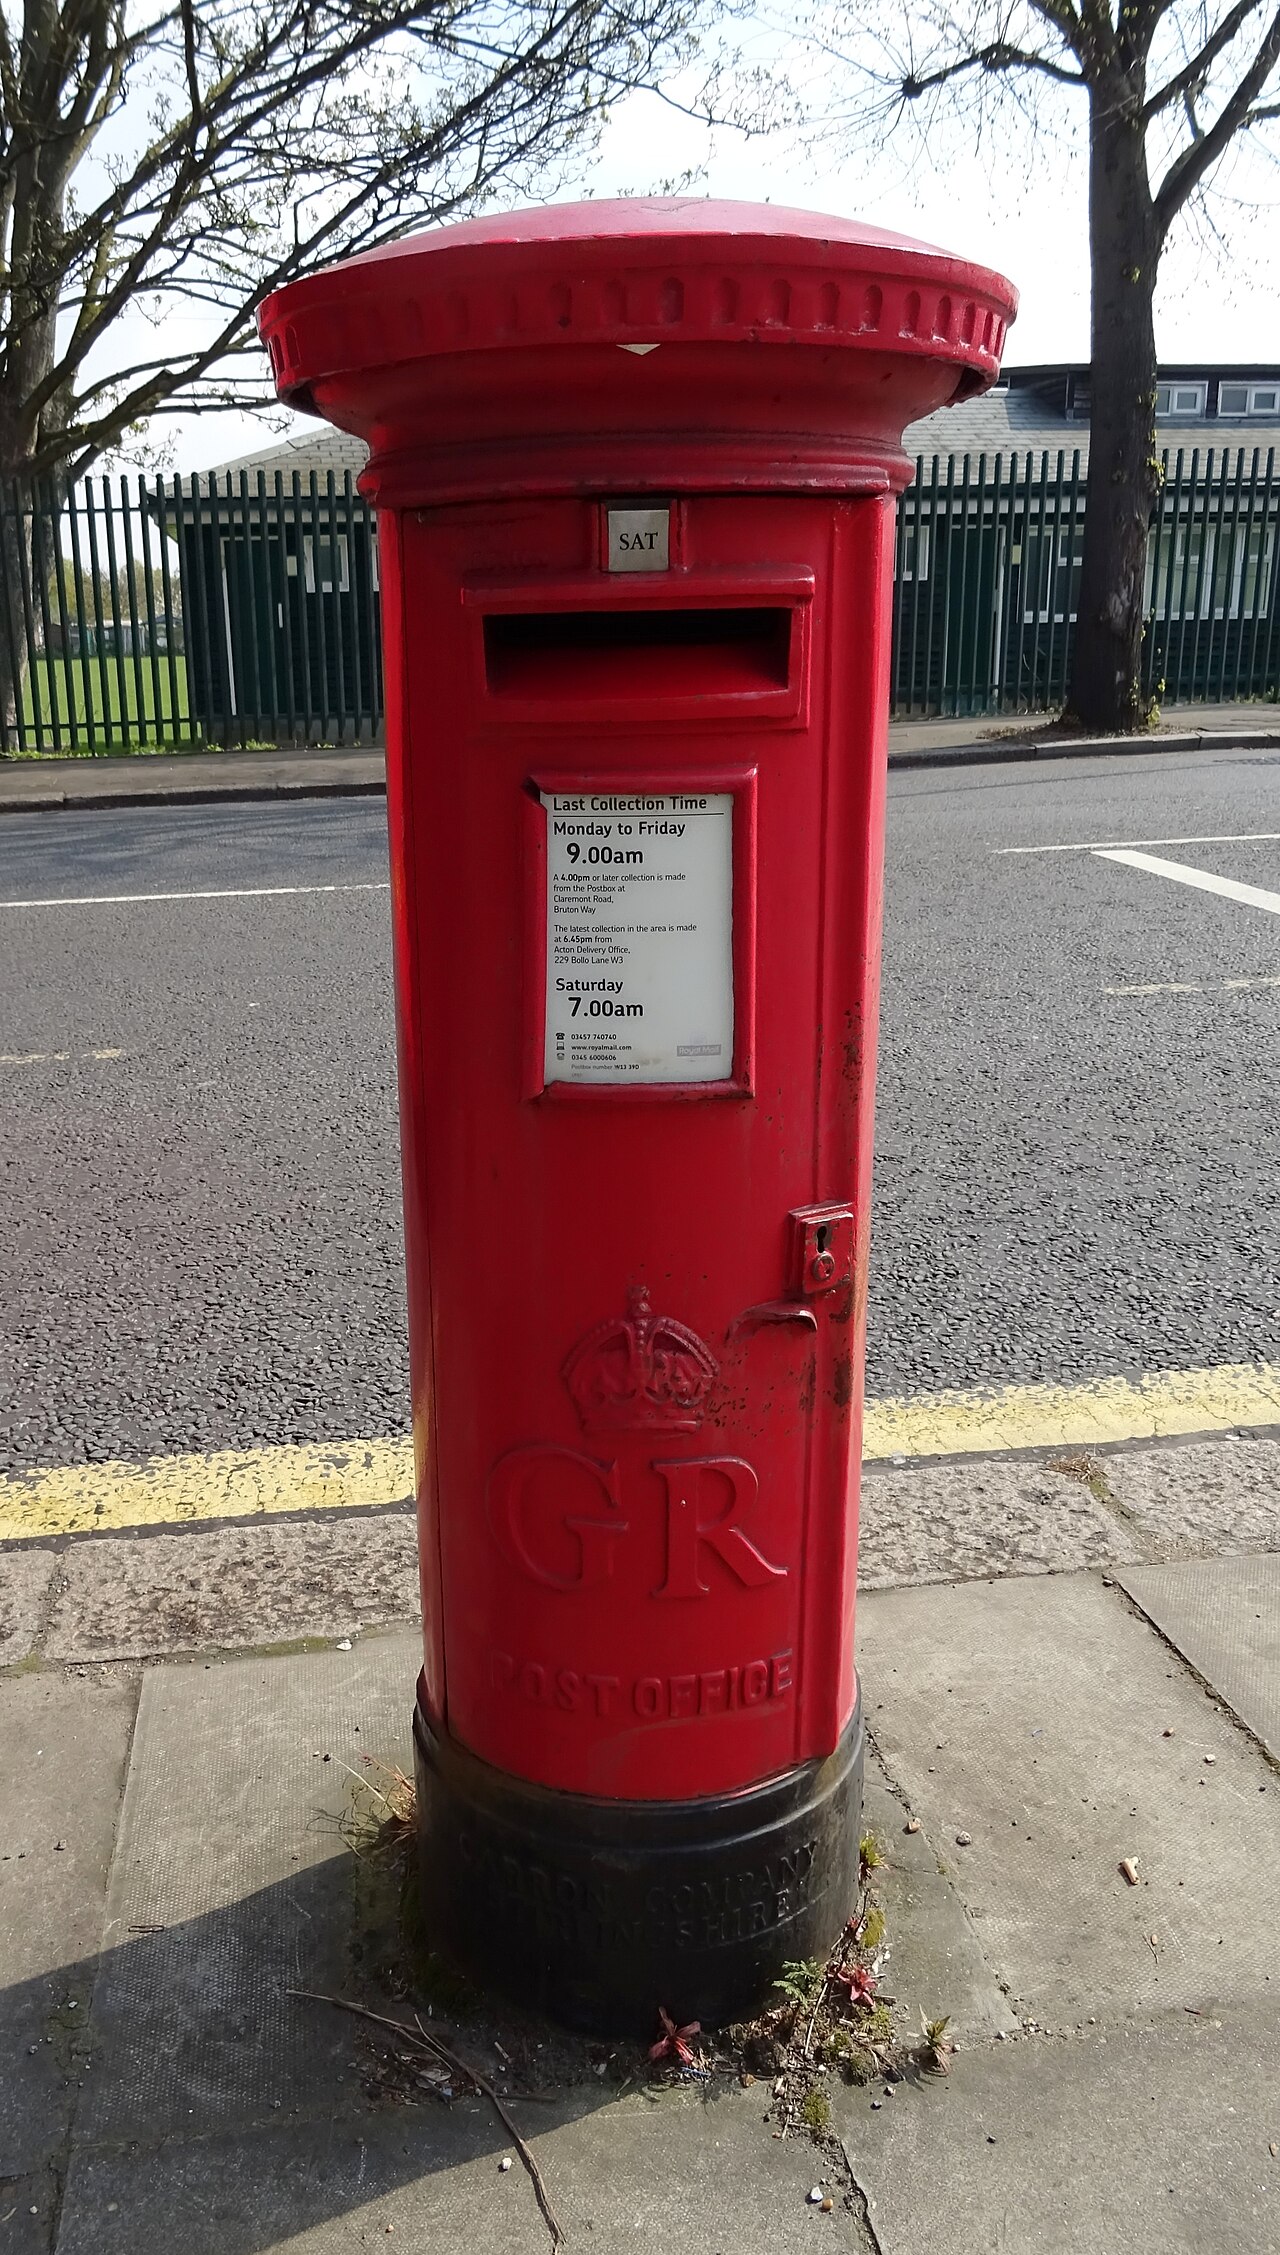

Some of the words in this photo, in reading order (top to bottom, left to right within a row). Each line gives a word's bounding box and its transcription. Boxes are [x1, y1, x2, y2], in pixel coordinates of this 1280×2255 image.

[619, 532, 658, 550] SAT
[553, 797, 585, 811] Last
[591, 796, 664, 811] Collection
[670, 796, 707, 810] Time
[554, 822, 612, 838] Monday
[617, 823, 632, 835] to
[639, 821, 685, 837] Friday
[567, 843, 643, 864] 9.00am
[553, 874, 559, 882] A
[561, 874, 590, 883] 4.00pm
[602, 874, 619, 882] later
[621, 874, 655, 882] collection
[657, 873, 663, 882] is
[665, 873, 685, 881] made
[554, 884, 571, 893] from
[573, 885, 585, 893] the
[587, 885, 615, 893] Postbox
[618, 885, 625, 893] at
[554, 895, 591, 904] Claremont
[593, 895, 613, 904] Road,
[554, 906, 579, 914] Bruton
[580, 906, 596, 916] Way
[554, 925, 568, 933] The
[570, 925, 589, 933] latest
[592, 925, 625, 933] collection
[628, 925, 634, 933] in
[637, 925, 648, 933] the
[651, 925, 666, 933] area
[669, 924, 674, 932] is
[677, 924, 696, 932] made
[554, 935, 561, 943] at
[564, 935, 592, 945] 6.45pm
[595, 936, 612, 944] from
[554, 946, 574, 954] Acton
[577, 946, 606, 956] Delivery
[608, 946, 630, 955] Office,
[555, 956, 569, 964] 229
[571, 956, 589, 965] Bollo
[592, 957, 609, 965] Lane
[611, 956, 623, 965] W3
[556, 978, 623, 994] Saturday
[568, 997, 643, 1017] 7.00am
[571, 1033, 590, 1041] 03457
[593, 1033, 616, 1041] 740740
[572, 1044, 631, 1052] www.royalmail.com
[490, 1649, 619, 1718] POST
[632, 1647, 794, 1719] OFFICE
